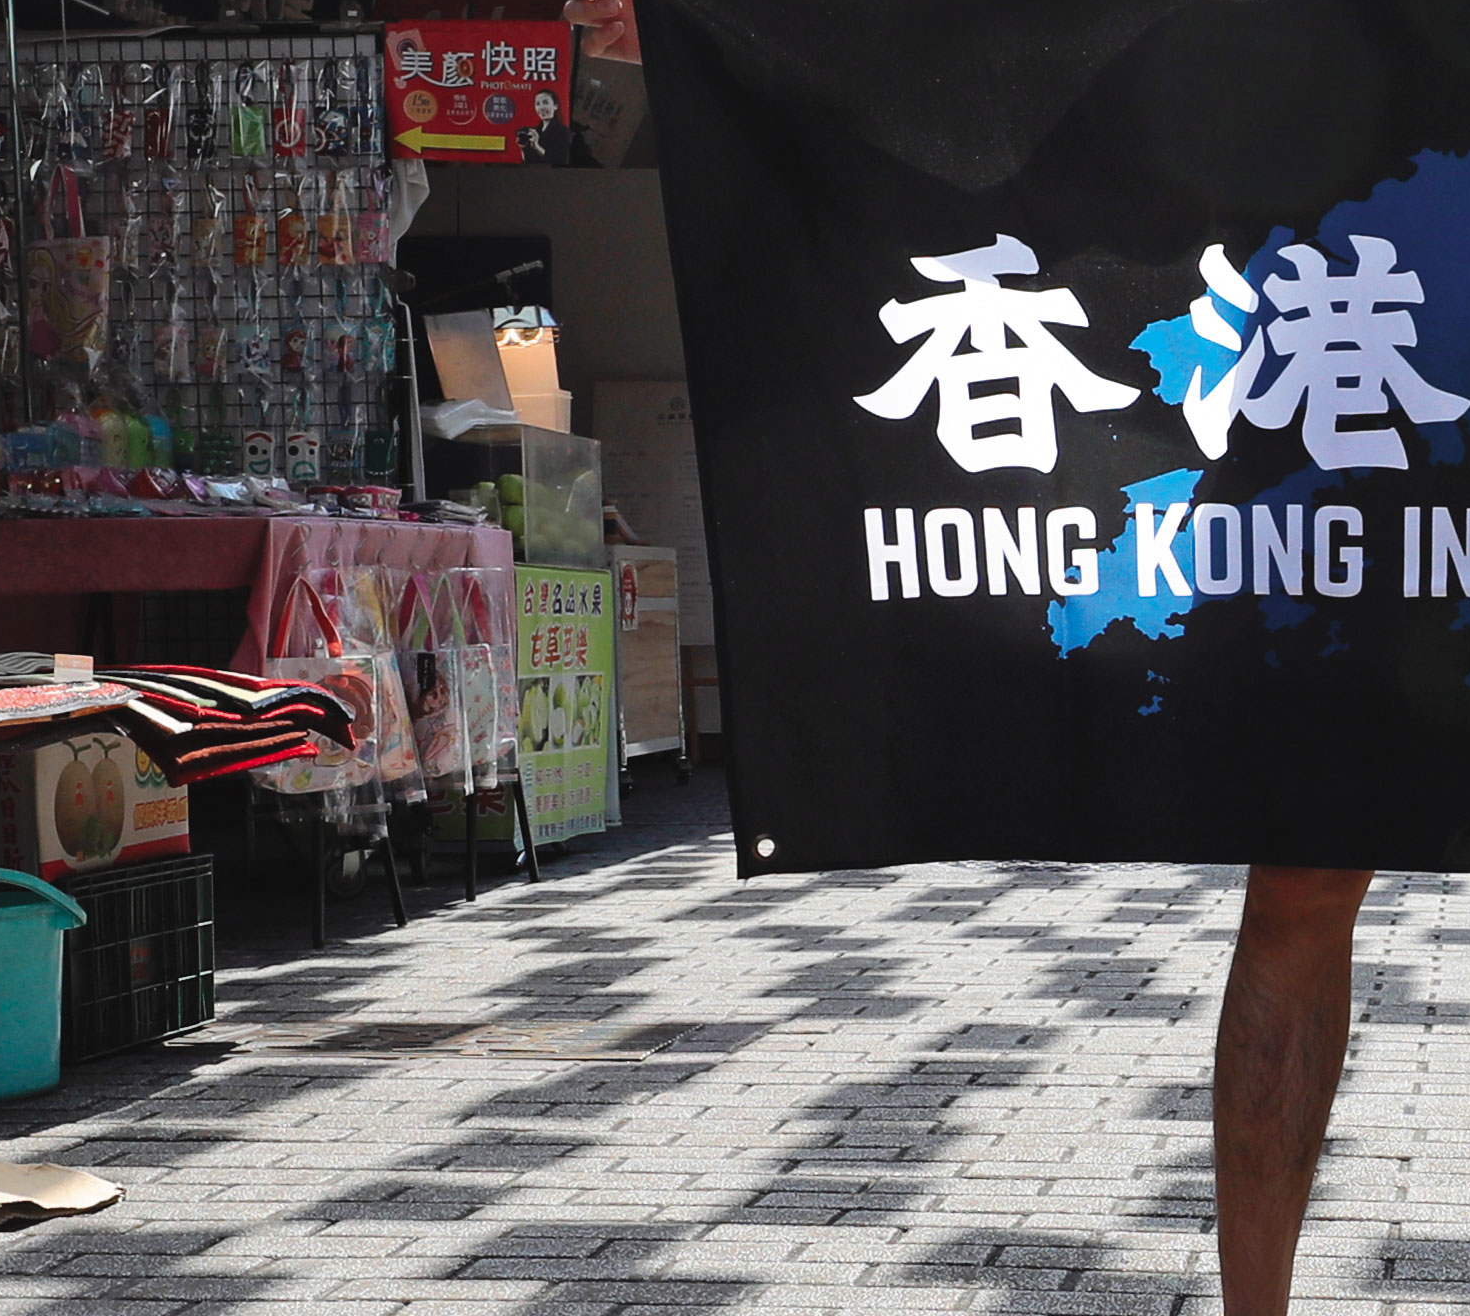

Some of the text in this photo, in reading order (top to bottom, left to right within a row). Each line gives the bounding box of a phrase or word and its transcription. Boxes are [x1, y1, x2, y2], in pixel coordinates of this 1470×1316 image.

[400, 40, 559, 88] 美顏快照
[863, 503, 1100, 603] HONG
[1135, 503, 1364, 601] KONG
[523, 580, 604, 616] 台灣名品水果
[530, 624, 590, 671] 甘草芭樂
